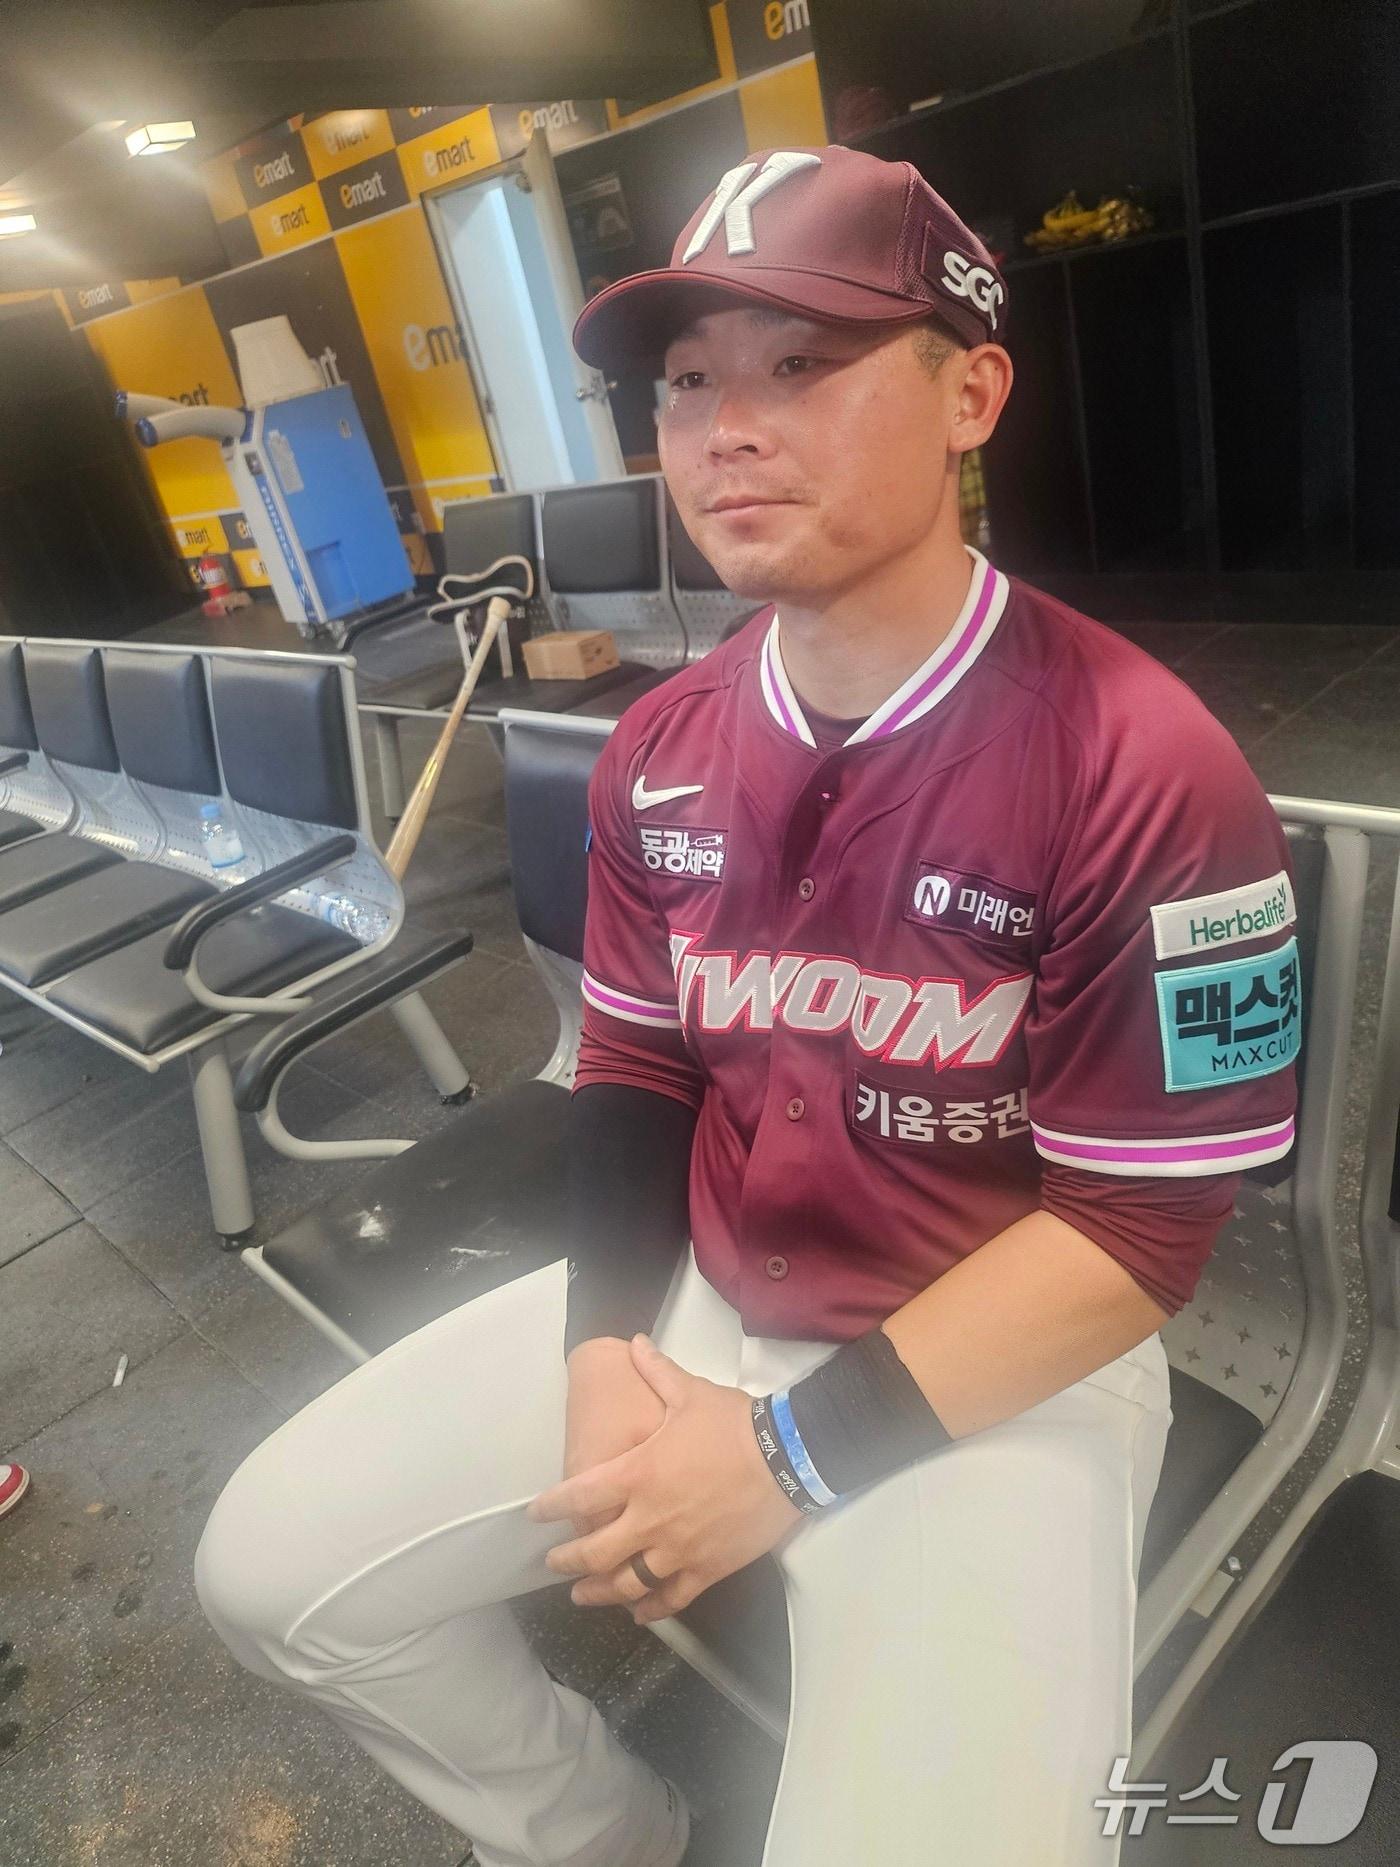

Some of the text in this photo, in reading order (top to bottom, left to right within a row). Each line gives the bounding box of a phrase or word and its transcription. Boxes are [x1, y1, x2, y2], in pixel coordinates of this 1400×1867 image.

[254, 152, 295, 188] emart
[424, 136, 476, 177] emart
[340, 171, 386, 208] emart
[683, 152, 821, 264] K
[271, 204, 309, 236] emart
[78, 283, 114, 308] emart
[640, 828, 724, 877] 동광제약
[1190, 895, 1287, 945] Herbalife
[1211, 1032, 1294, 1072] MAXCUT
[855, 1082, 1031, 1144] 키움증권
[760, 1429, 779, 1461] Vibes
[778, 1470, 800, 1497] Vibes
